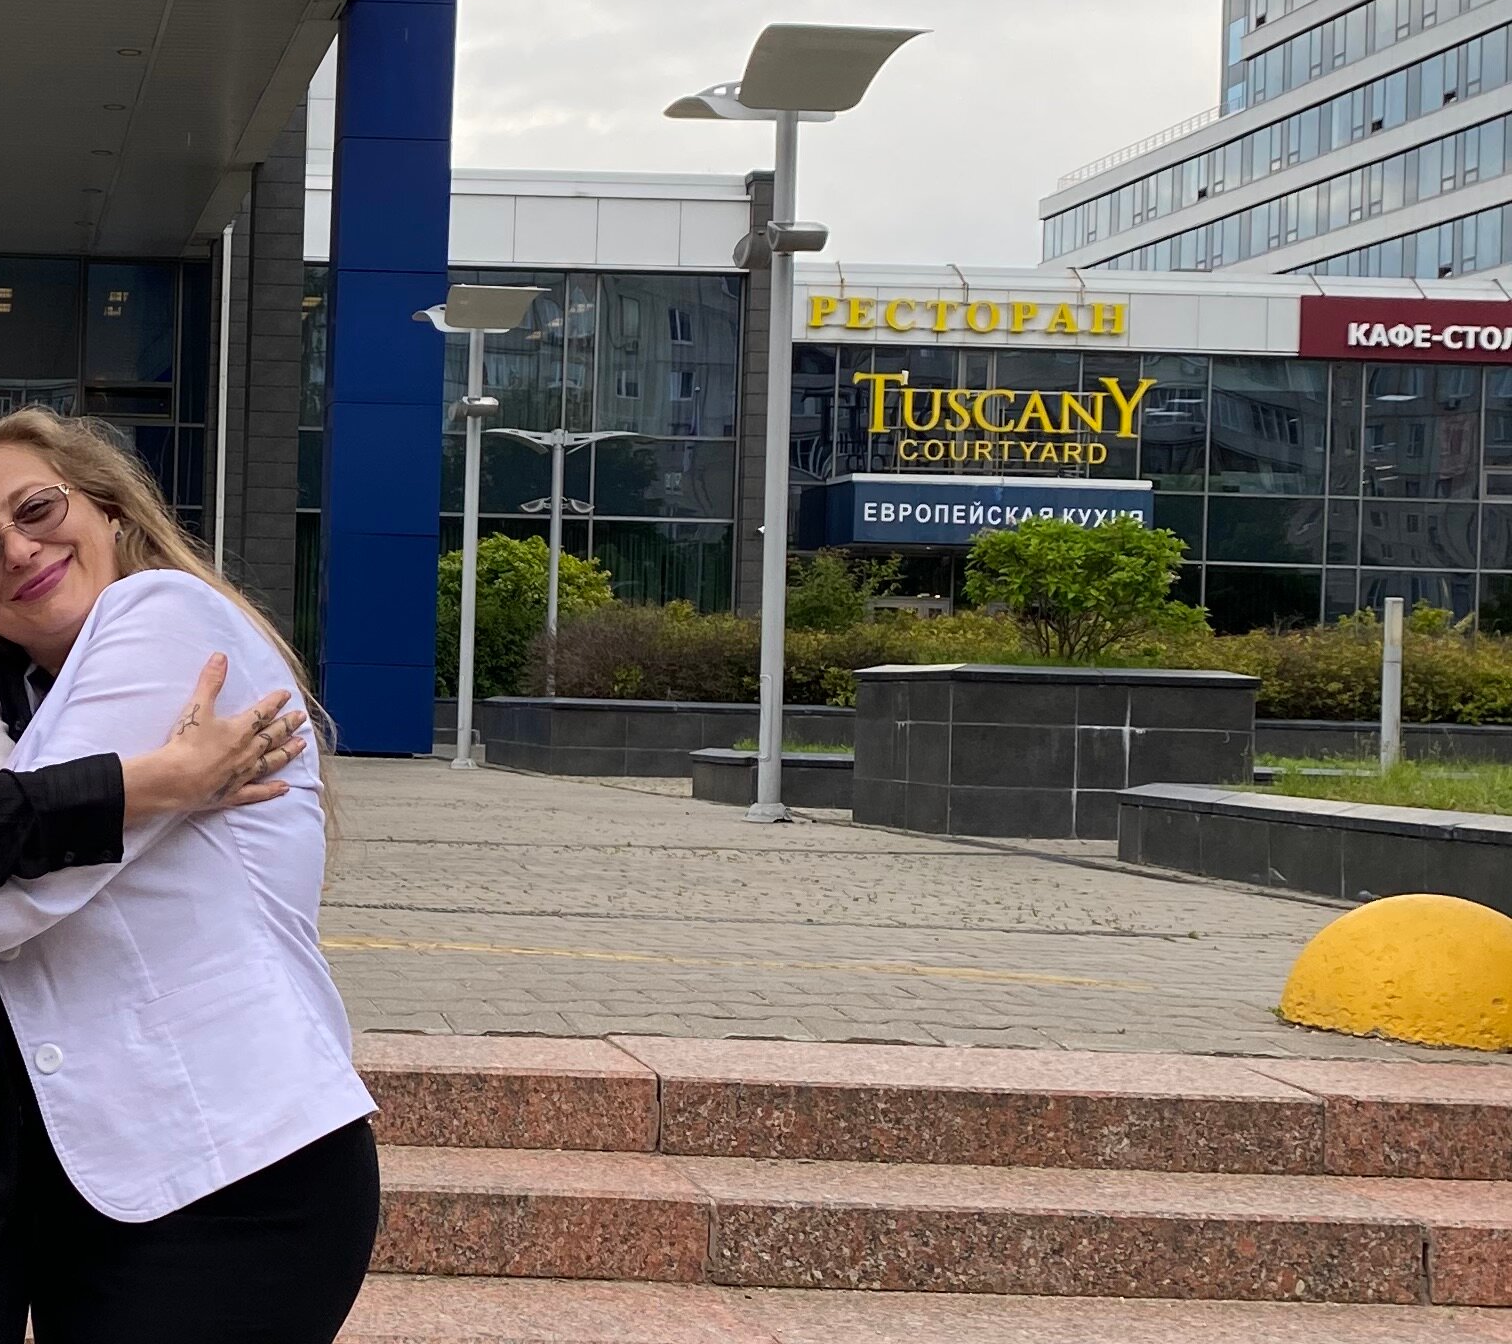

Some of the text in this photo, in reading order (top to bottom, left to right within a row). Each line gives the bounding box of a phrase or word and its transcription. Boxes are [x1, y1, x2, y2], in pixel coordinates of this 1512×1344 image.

[808, 295, 1125, 335] РЕСТОРАН
[852, 370, 1157, 438] TUSCANY
[899, 438, 1108, 465] COURTYARD
[863, 501, 1054, 526] ЕВРОПЕЙСКАЯ
